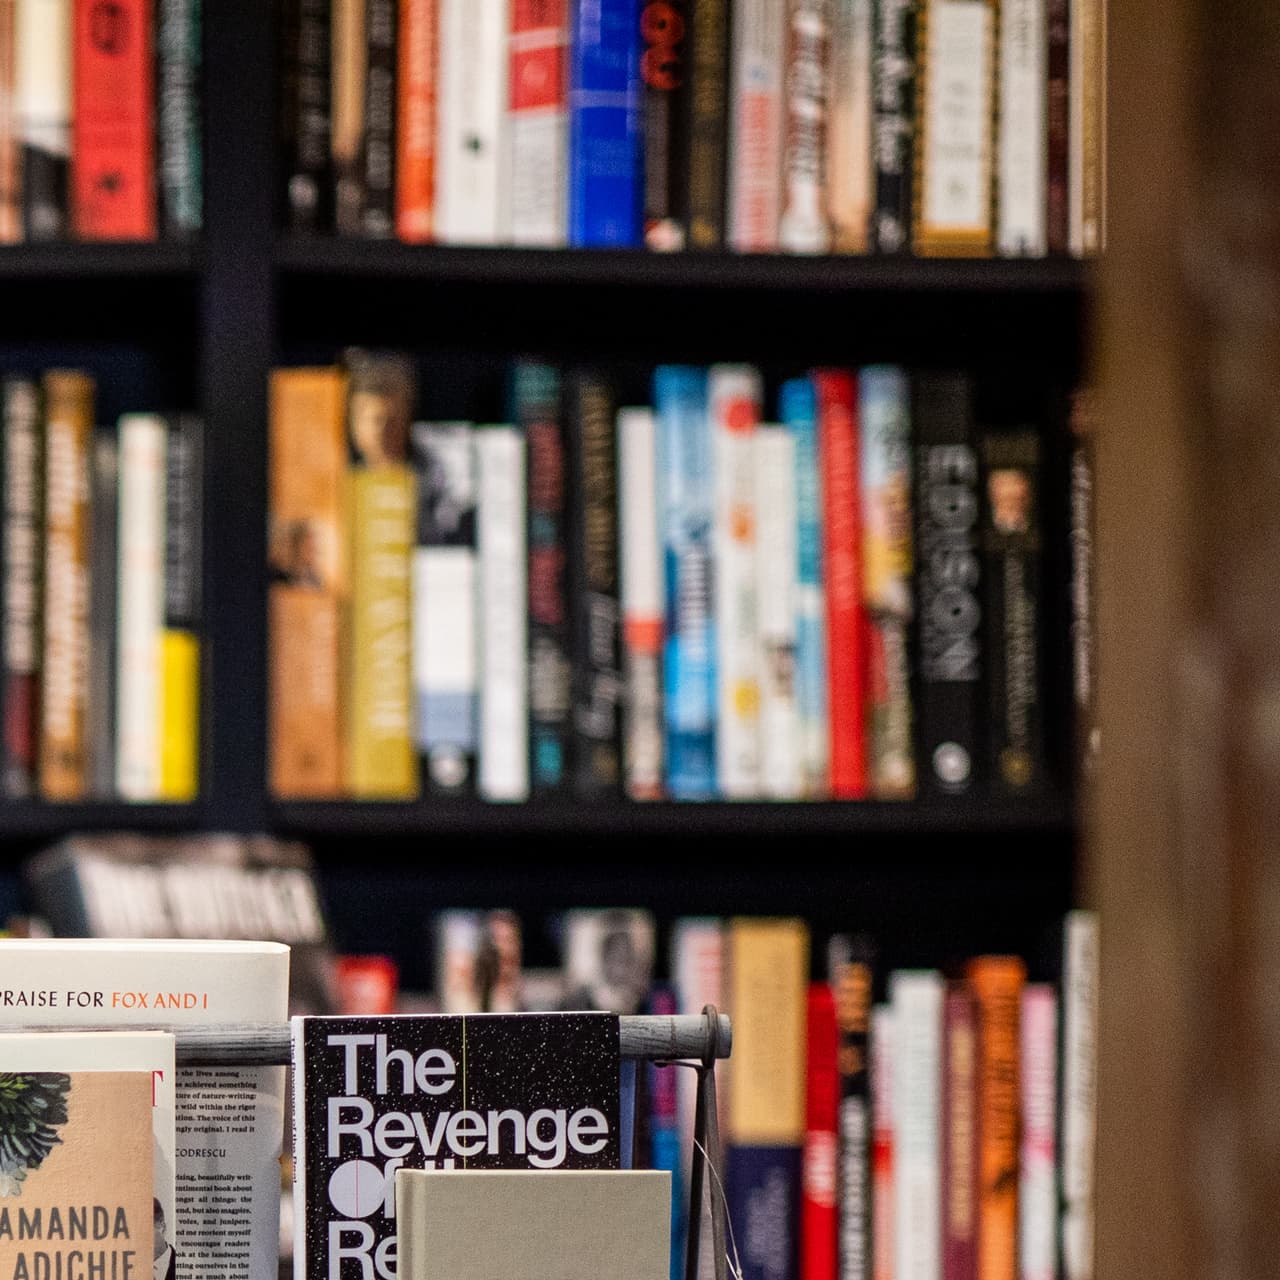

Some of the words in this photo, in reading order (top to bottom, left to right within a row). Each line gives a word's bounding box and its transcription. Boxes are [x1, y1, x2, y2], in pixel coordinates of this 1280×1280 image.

[921, 443, 981, 683] EDISON
[66, 991, 105, 1008] FOR
[111, 992, 148, 1009] FOX
[153, 993, 198, 1009] AND
[327, 1034, 456, 1095] The
[327, 1097, 609, 1168] Revenge
[327, 1221, 397, 1280] Re
